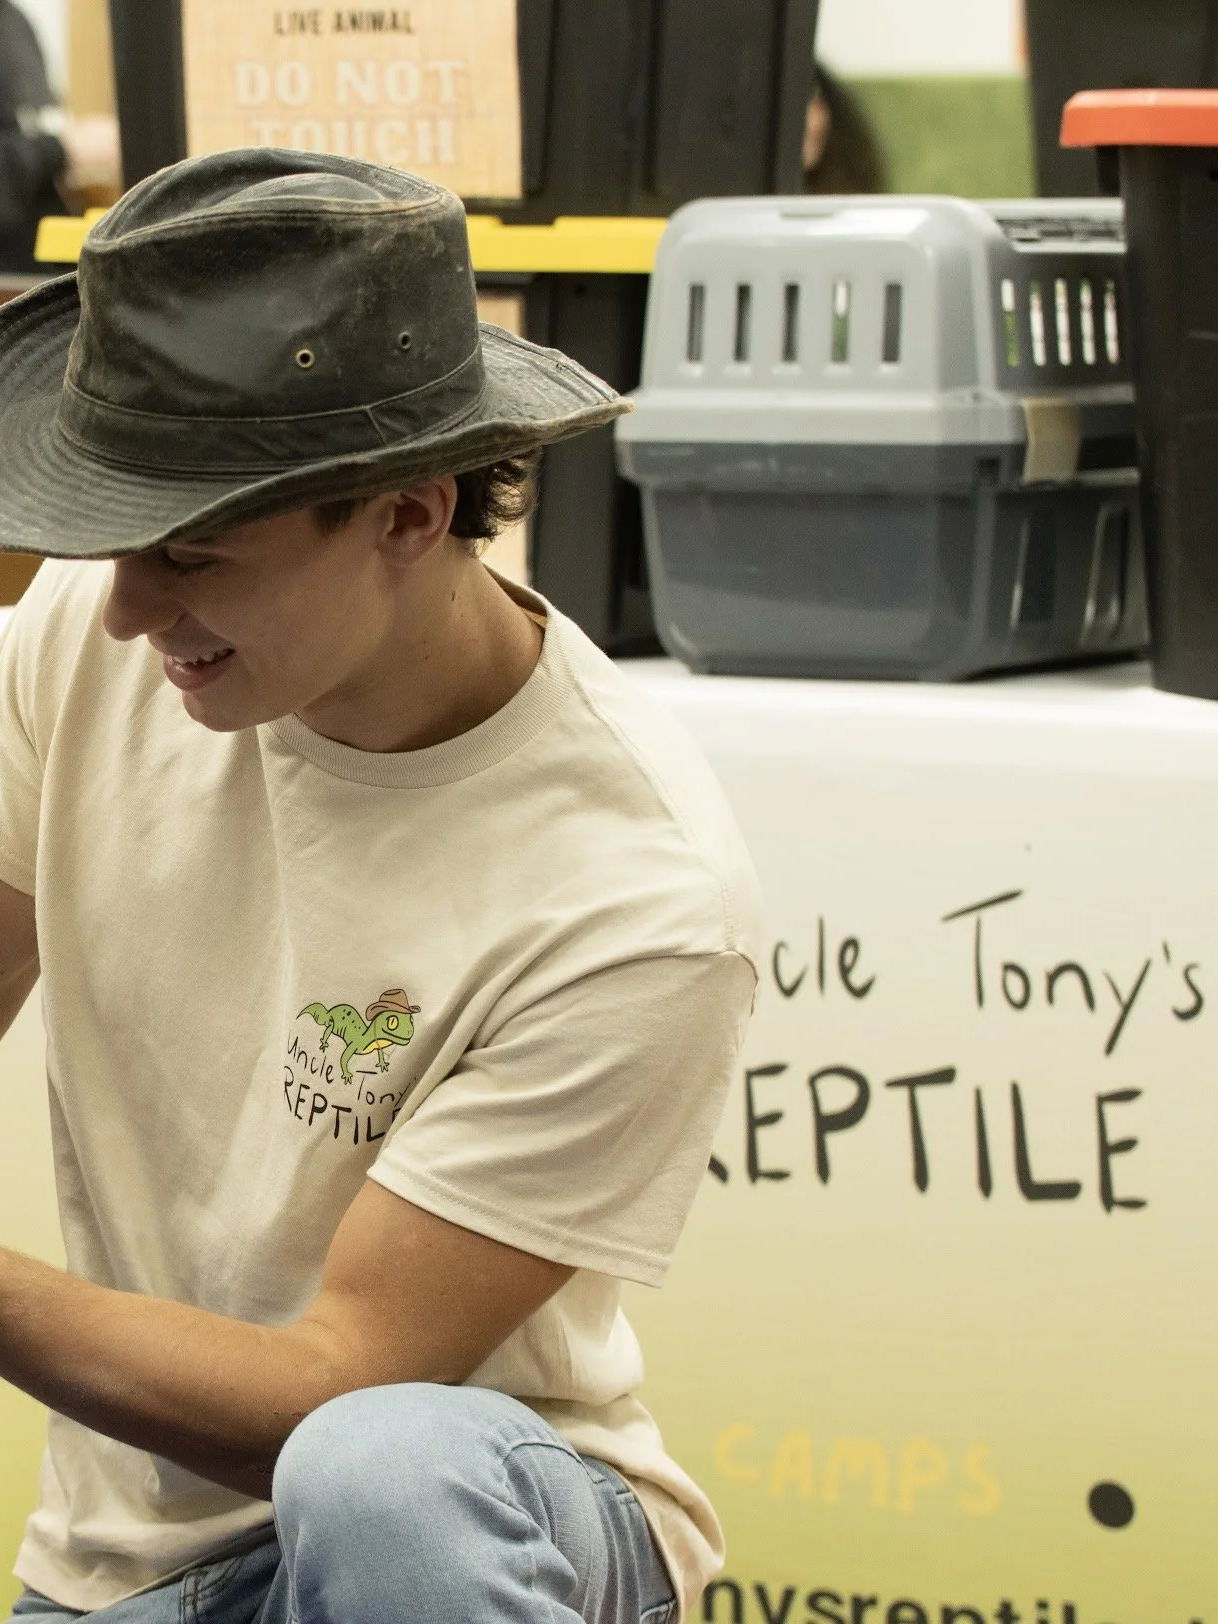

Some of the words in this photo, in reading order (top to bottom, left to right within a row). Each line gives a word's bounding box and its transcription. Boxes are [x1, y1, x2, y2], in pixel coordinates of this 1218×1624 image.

[273, 10, 322, 36] LIVE
[333, 8, 415, 34] ANIMAL
[235, 60, 311, 108] DO
[336, 59, 466, 106] NOT
[251, 119, 457, 164] TOUCH
[772, 914, 877, 999] cle
[942, 889, 1205, 1057] Tony's
[287, 1030, 335, 1084] Uncle
[355, 1070, 418, 1107] Tony
[707, 1063, 1148, 1214] EPTILE
[713, 1423, 1002, 1517] CAMPS
